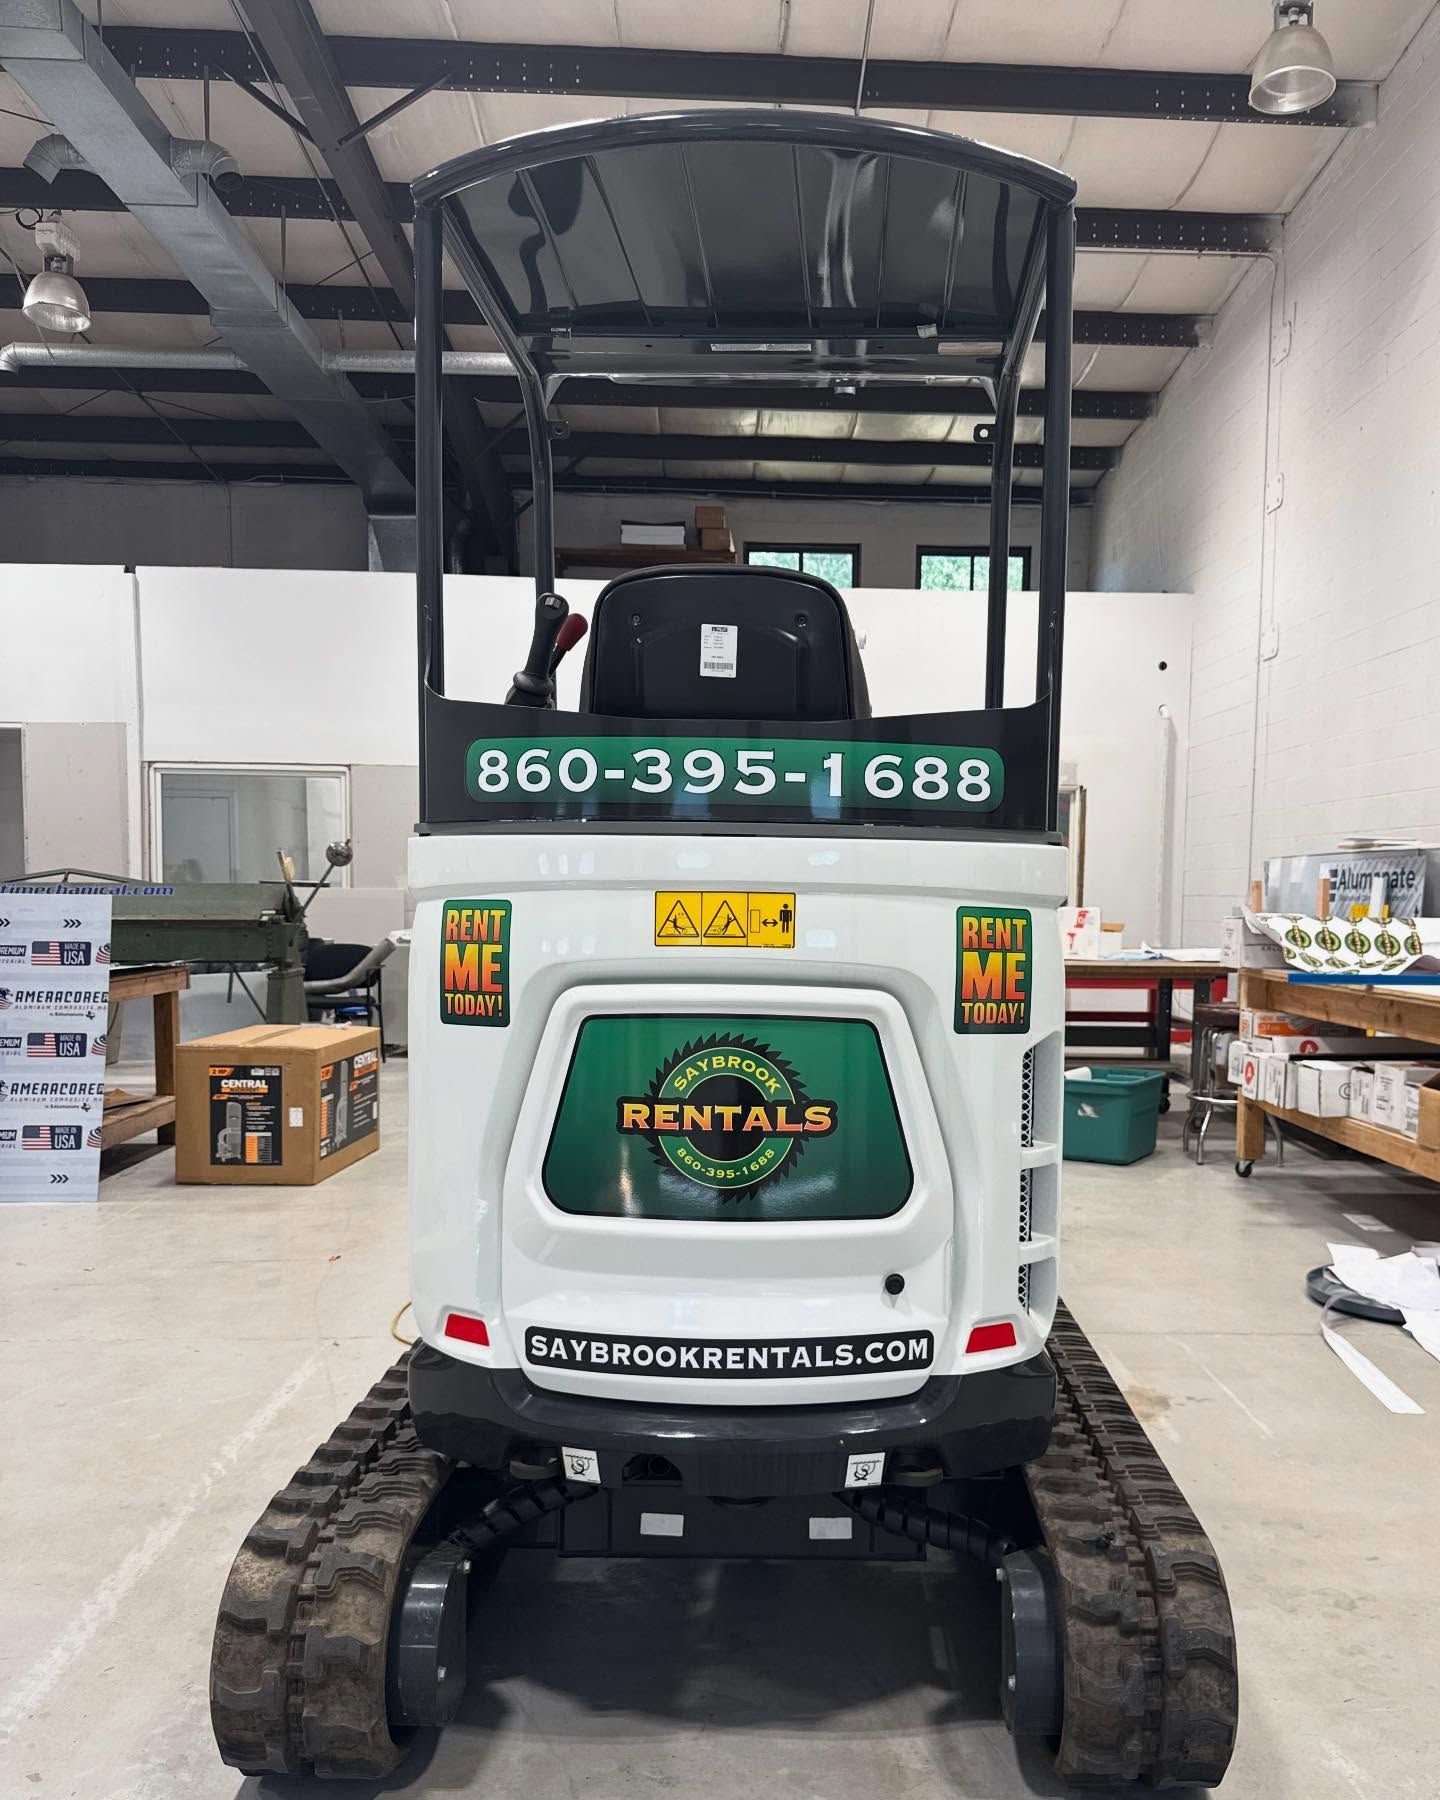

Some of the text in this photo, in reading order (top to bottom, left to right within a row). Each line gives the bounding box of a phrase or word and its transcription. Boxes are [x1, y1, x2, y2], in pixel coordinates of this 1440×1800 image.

[477, 748, 991, 803] 860-395-1688
[1337, 868, 1415, 890] Alumnate
[445, 909, 505, 942] RENT
[962, 916, 1027, 950] RENT
[64, 951, 85, 964] USA
[445, 943, 503, 992] ME
[962, 951, 1026, 1000] ME
[445, 994, 503, 1017] TODAY!
[961, 1002, 1025, 1024] TODAY!
[59, 1042, 80, 1056] USA
[221, 1079, 268, 1088] CENTRAL
[673, 1055, 782, 1095] SAYBROOK
[622, 1103, 832, 1133] RENTALS
[54, 1135, 76, 1149] USA
[676, 1148, 775, 1179] 860-395-1688
[530, 1335, 929, 1369] SAYBROOKRENTALS.COM
